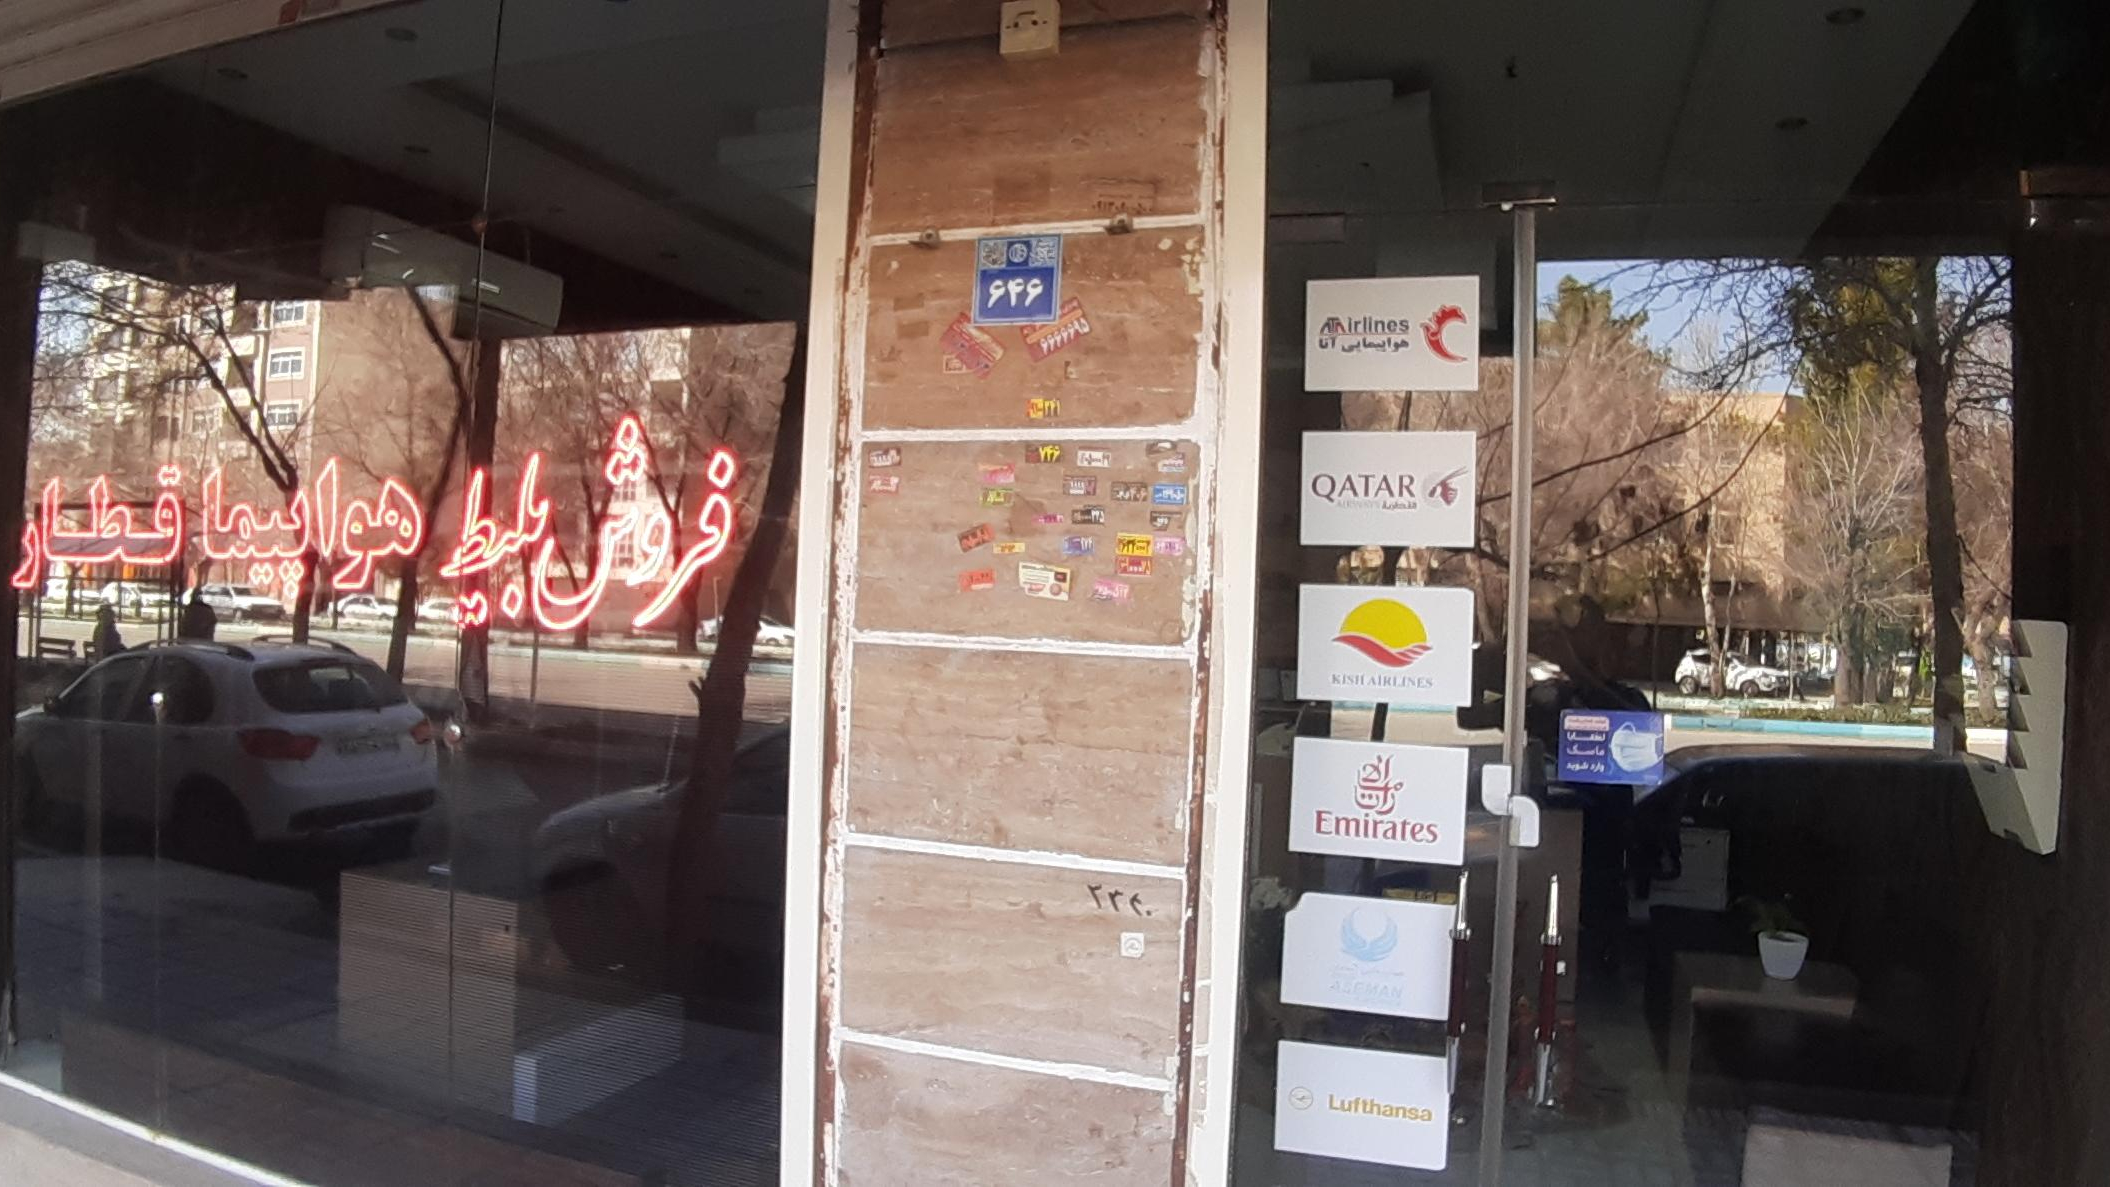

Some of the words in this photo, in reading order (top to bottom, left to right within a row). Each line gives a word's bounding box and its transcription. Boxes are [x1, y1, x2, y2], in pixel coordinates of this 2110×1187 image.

[986, 278, 1044, 309] ۶۴۶
[1311, 473, 1416, 503] QATAR
[10, 462, 183, 590] قطار
[201, 455, 423, 600] هواپیما
[532, 409, 738, 630] فروش
[438, 449, 551, 628] بلیط
[1331, 673, 1365, 686] KISH
[1367, 675, 1434, 689] AIRLINES
[1314, 810, 1439, 844] Emirates
[1328, 1093, 1433, 1122] Lufthansa
